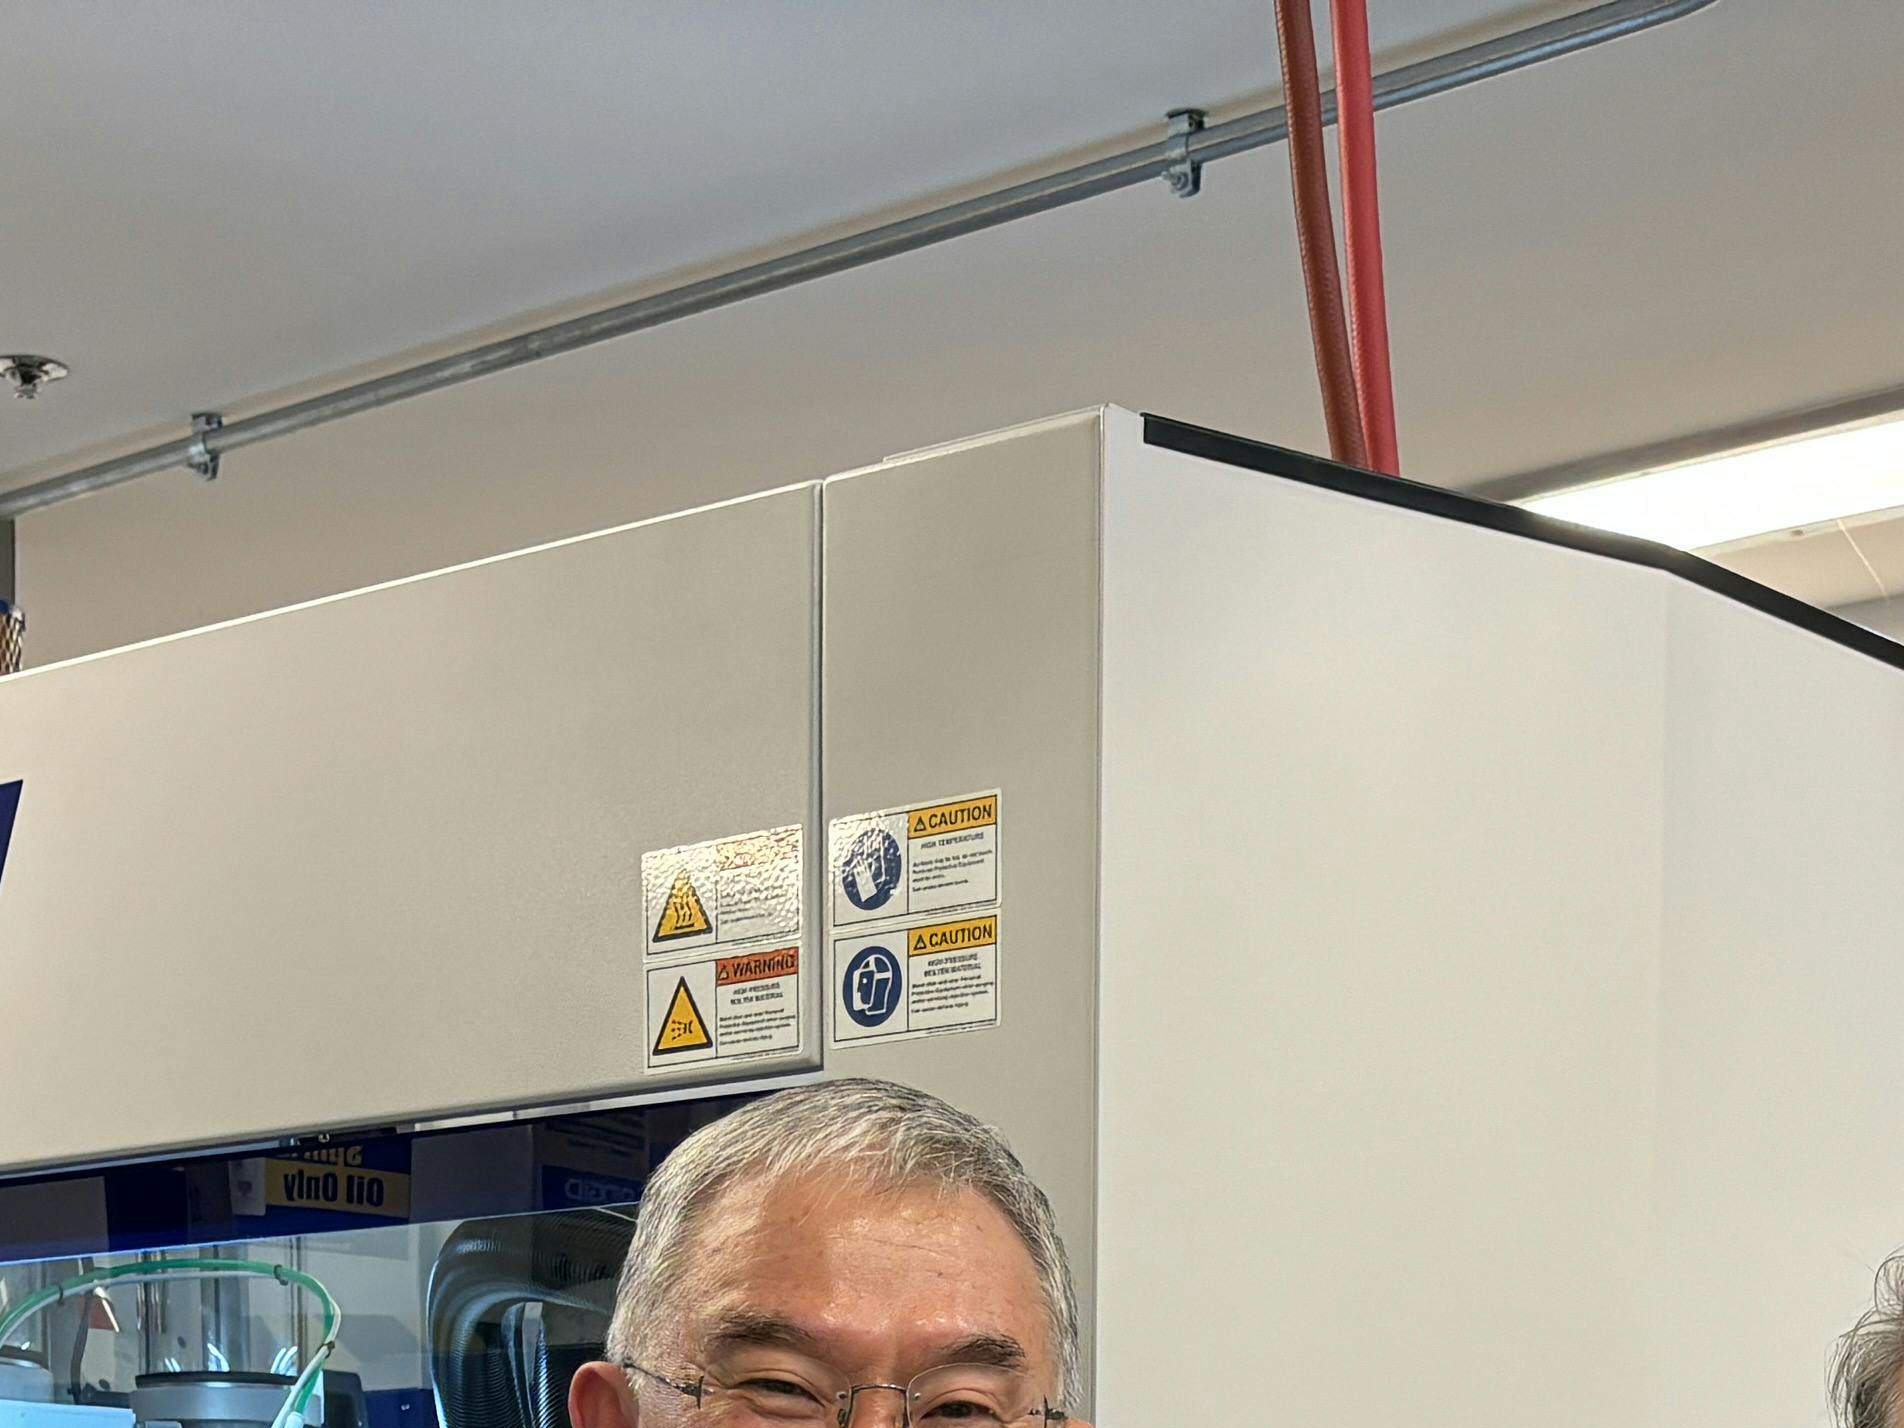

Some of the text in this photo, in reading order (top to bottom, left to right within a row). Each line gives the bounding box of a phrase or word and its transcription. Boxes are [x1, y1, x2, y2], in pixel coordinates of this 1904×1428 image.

[928, 804, 992, 829] CAUTION
[929, 924, 992, 948] CAUTION
[732, 954, 796, 977] WARNING
